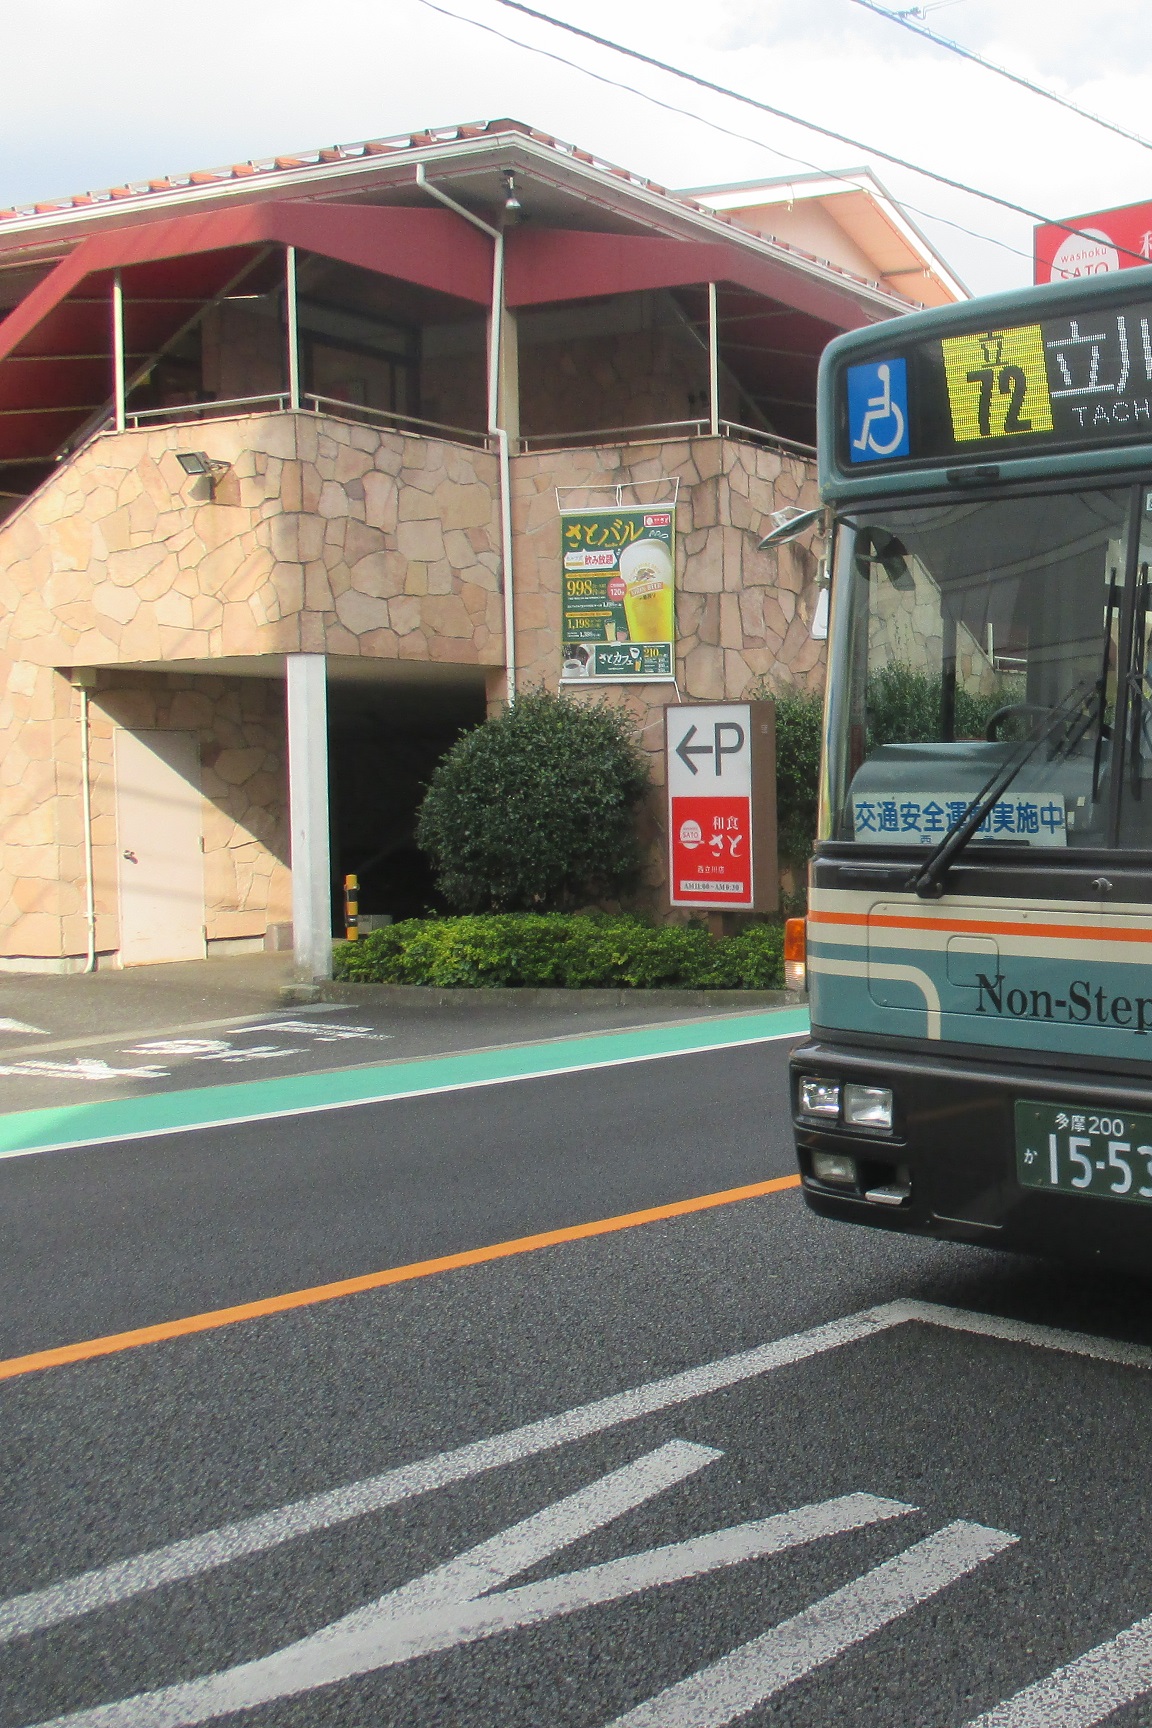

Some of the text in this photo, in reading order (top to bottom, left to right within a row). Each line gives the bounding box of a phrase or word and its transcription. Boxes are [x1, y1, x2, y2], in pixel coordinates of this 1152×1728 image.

[1061, 247, 1107, 263] washoku
[966, 365, 1033, 437] 72
[565, 518, 644, 548] さとバル
[566, 580, 592, 596] 998
[567, 618, 590, 630] 1,198
[599, 651, 634, 665] さとカフェ
[643, 648, 659, 657] 210
[714, 722, 745, 776] P
[713, 816, 739, 830] 和食
[682, 831, 699, 839] SATO
[708, 833, 743, 858] さと
